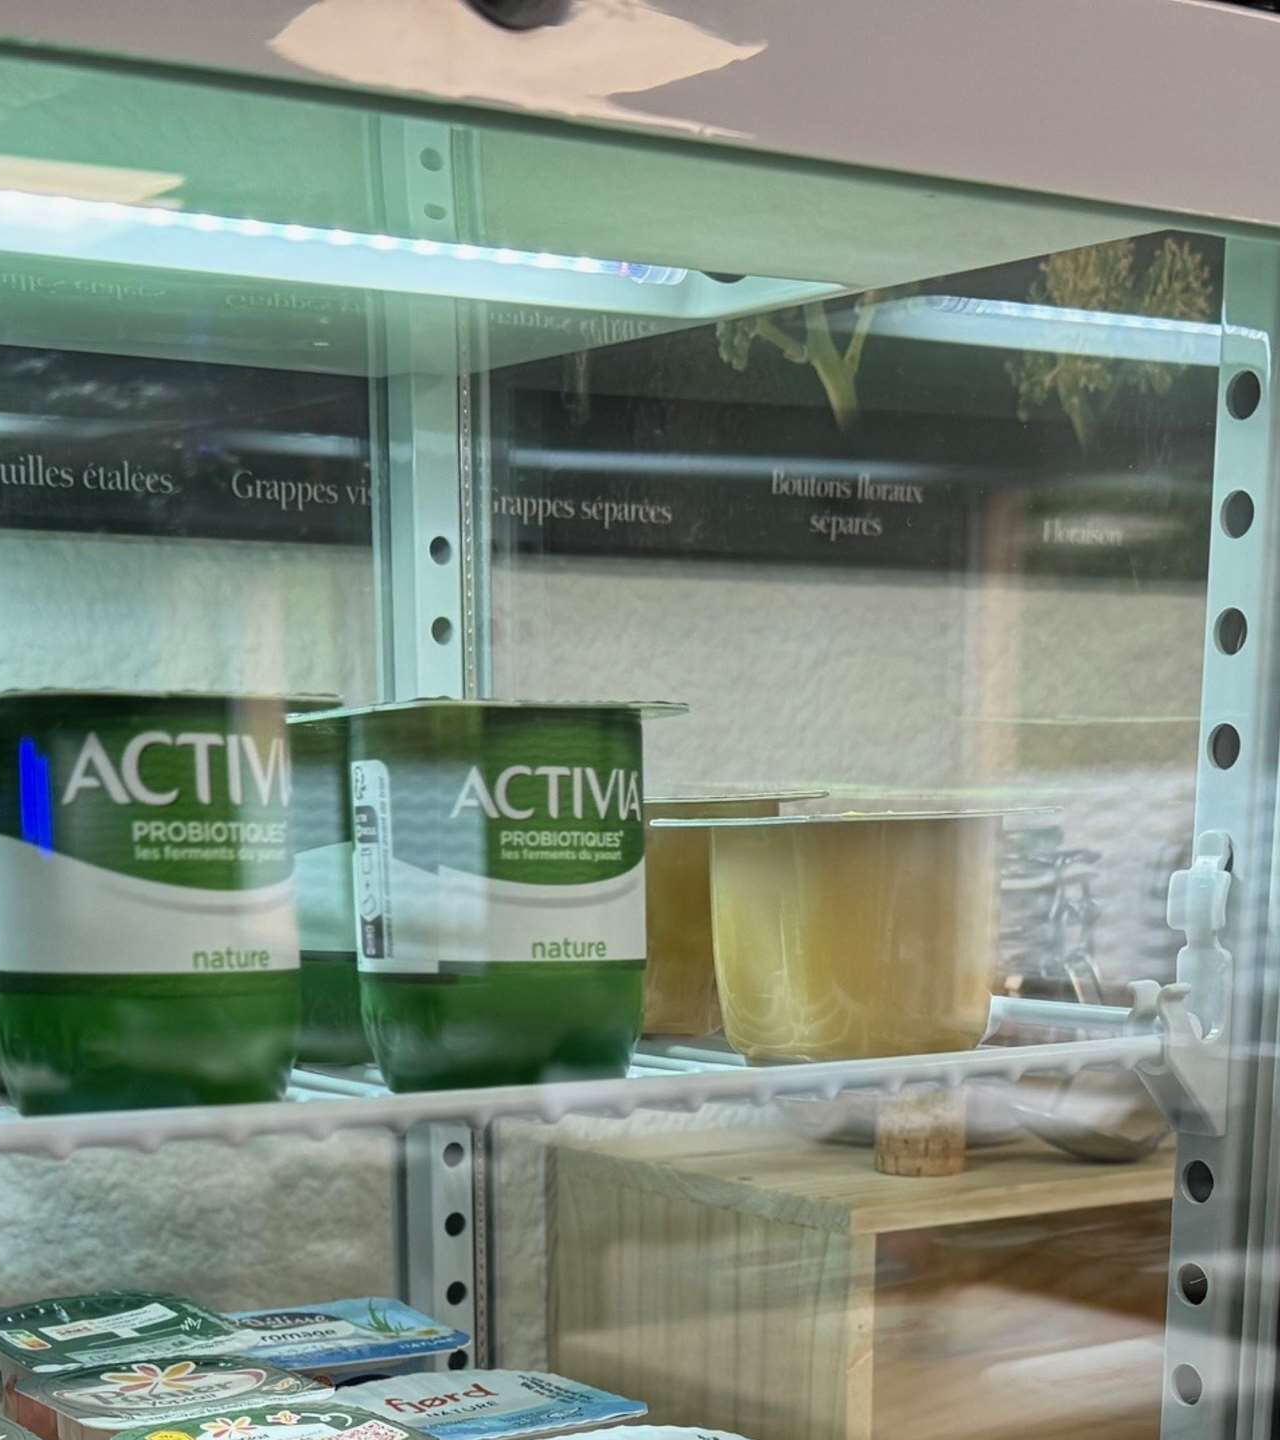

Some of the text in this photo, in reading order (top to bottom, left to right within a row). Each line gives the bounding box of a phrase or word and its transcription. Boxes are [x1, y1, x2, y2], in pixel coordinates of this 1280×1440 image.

[82, 459, 176, 495] étalées
[231, 469, 339, 512] Grappes
[771, 469, 924, 504] Boutons floraux
[580, 492, 673, 528] séparées
[809, 509, 884, 542] séparés
[449, 764, 642, 822] ACTIVIA
[192, 946, 271, 970] nature
[530, 938, 607, 959] nature
[259, 1327, 337, 1343] romage
